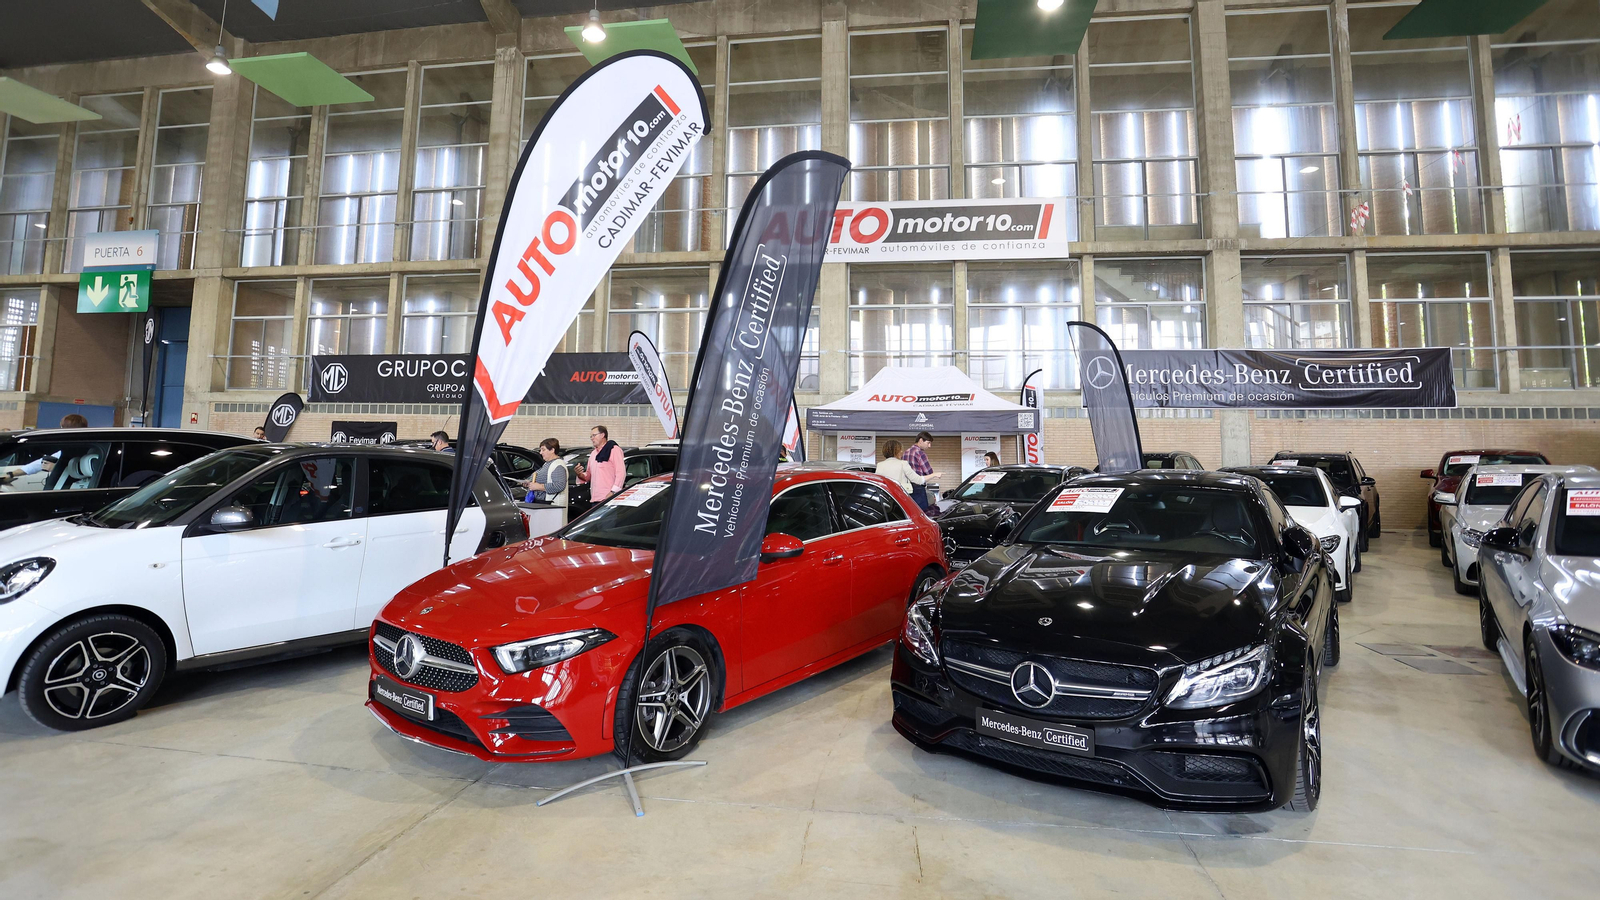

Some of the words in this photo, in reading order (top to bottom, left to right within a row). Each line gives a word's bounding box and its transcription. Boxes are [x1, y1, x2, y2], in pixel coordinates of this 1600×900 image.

[586, 177, 633, 239] automóviles
[634, 161, 646, 176] de
[647, 113, 687, 160] confianza
[598, 121, 701, 249] CADIMAR-FEVIMAR
[94, 246, 130, 258] PUERTA
[136, 246, 143, 257] 6
[881, 242, 955, 253] automóviles
[961, 242, 976, 251] de
[982, 241, 1046, 251] confianza
[491, 210, 577, 347] AUTO
[322, 365, 347, 391] MG
[570, 371, 607, 383] AUTO
[1304, 361, 1415, 385] Certified
[694, 359, 755, 536] Mercedes-Benz
[739, 254, 781, 349] Certified
[753, 367, 770, 410] ocasión
[867, 394, 917, 403] AUTO
[1173, 390, 1224, 402] Premium
[1230, 391, 1243, 401] de
[1247, 390, 1295, 402] ocasión
[274, 405, 293, 425] MG
[749, 412, 759, 428] de
[736, 430, 755, 480] Premium
[723, 483, 744, 538] Vehículos
[377, 683, 402, 705] Mercedes-Benz
[403, 697, 424, 712] Certified
[981, 716, 1042, 740] Mercedes-Benz
[1046, 731, 1086, 748] Certified
